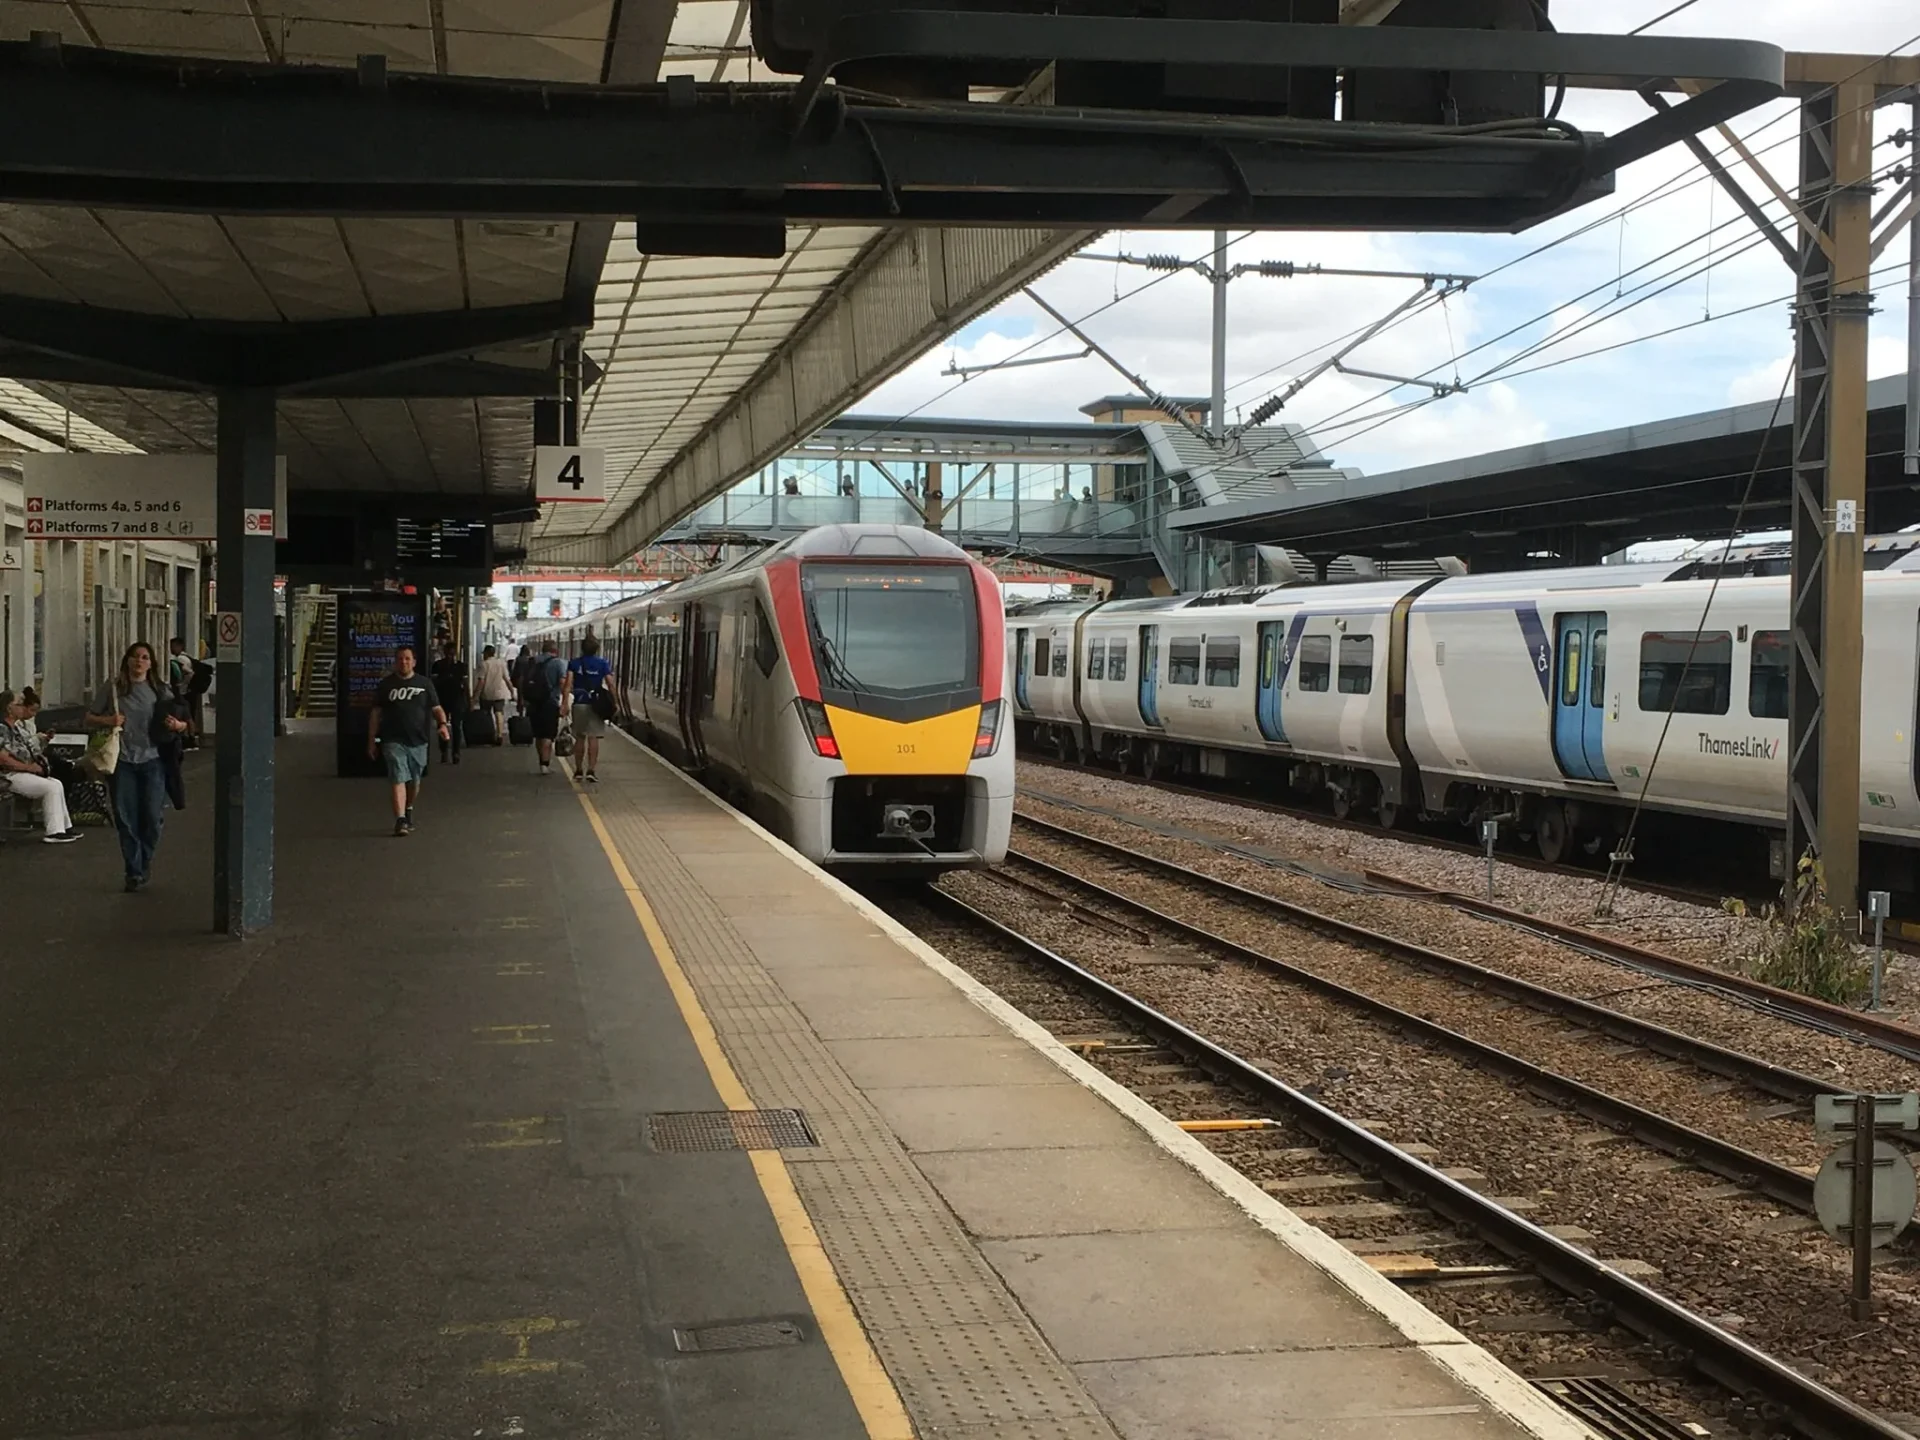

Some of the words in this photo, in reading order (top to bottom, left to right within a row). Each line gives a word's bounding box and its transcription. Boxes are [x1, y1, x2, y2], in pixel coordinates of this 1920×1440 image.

[557, 454, 585, 490] 4
[45, 500, 108, 512] Platforms
[111, 501, 131, 512] 4a,
[134, 501, 142, 512] 5
[146, 500, 169, 512] and
[172, 501, 181, 512] 6
[45, 521, 108, 533] Platforms
[111, 522, 120, 533] 7
[123, 522, 147, 533] and
[150, 522, 159, 533] 8
[518, 587, 527, 599] 4
[389, 687, 421, 701] 007
[896, 744, 916, 754] 101
